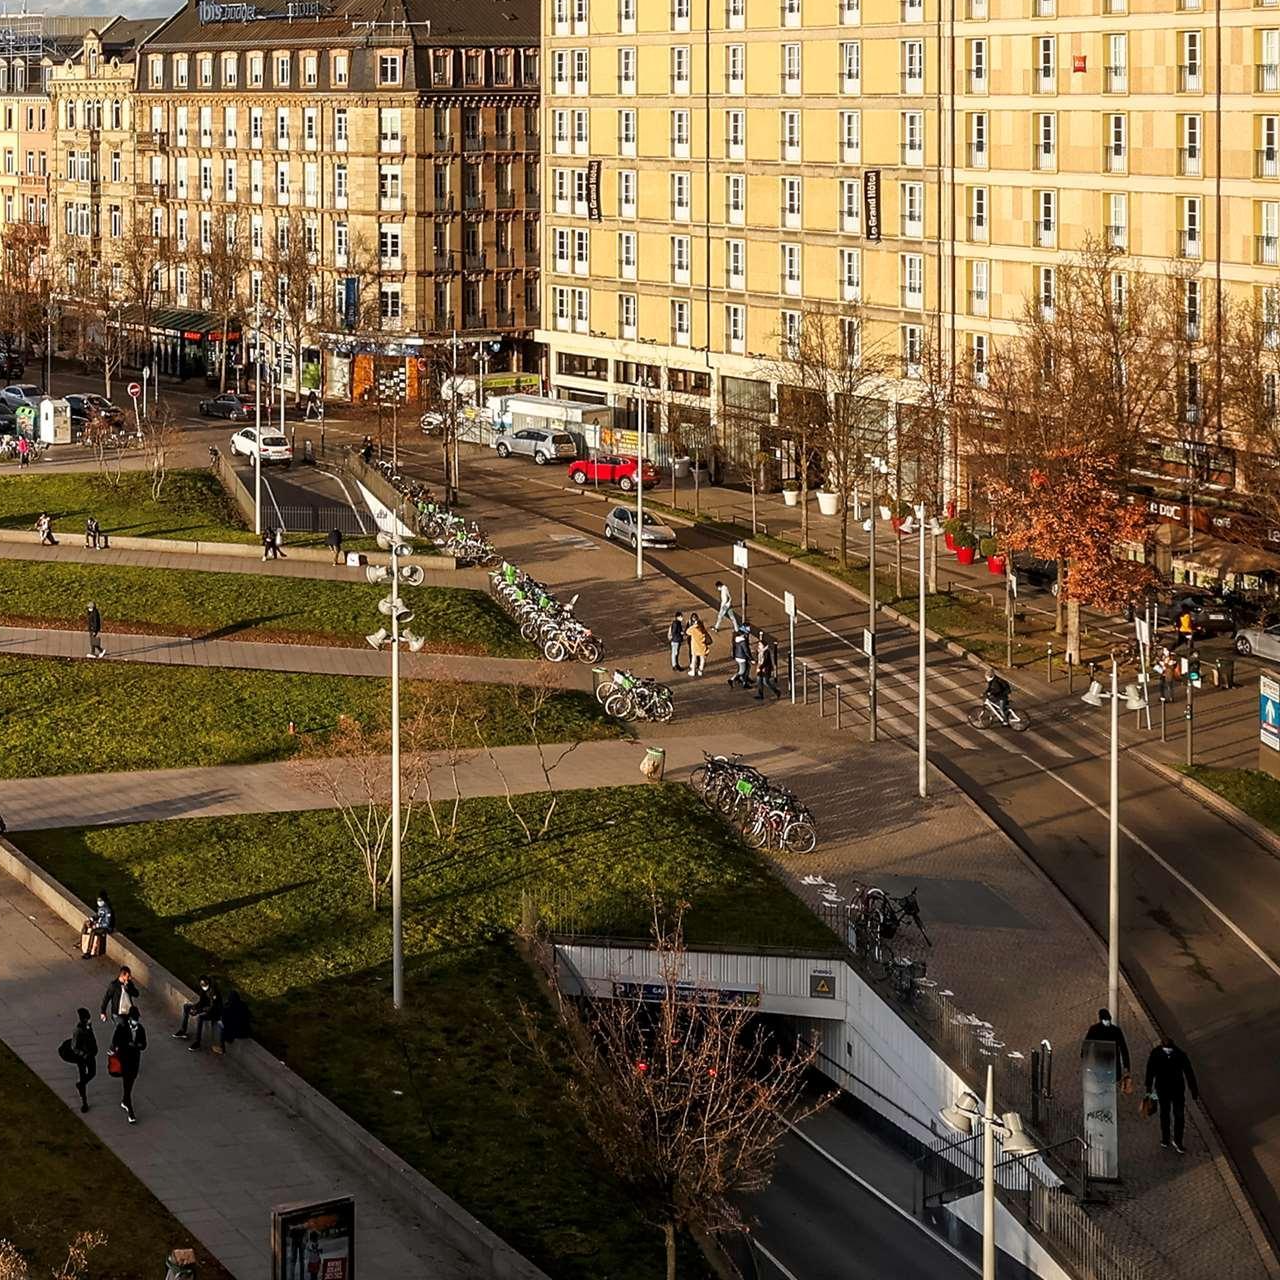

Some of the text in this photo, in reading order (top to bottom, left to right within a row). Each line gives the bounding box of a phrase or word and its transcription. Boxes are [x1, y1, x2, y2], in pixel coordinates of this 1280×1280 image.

[199, 0, 257, 22] ibis budget
[867, 199, 877, 226] Grand
[869, 226, 878, 239] Le
